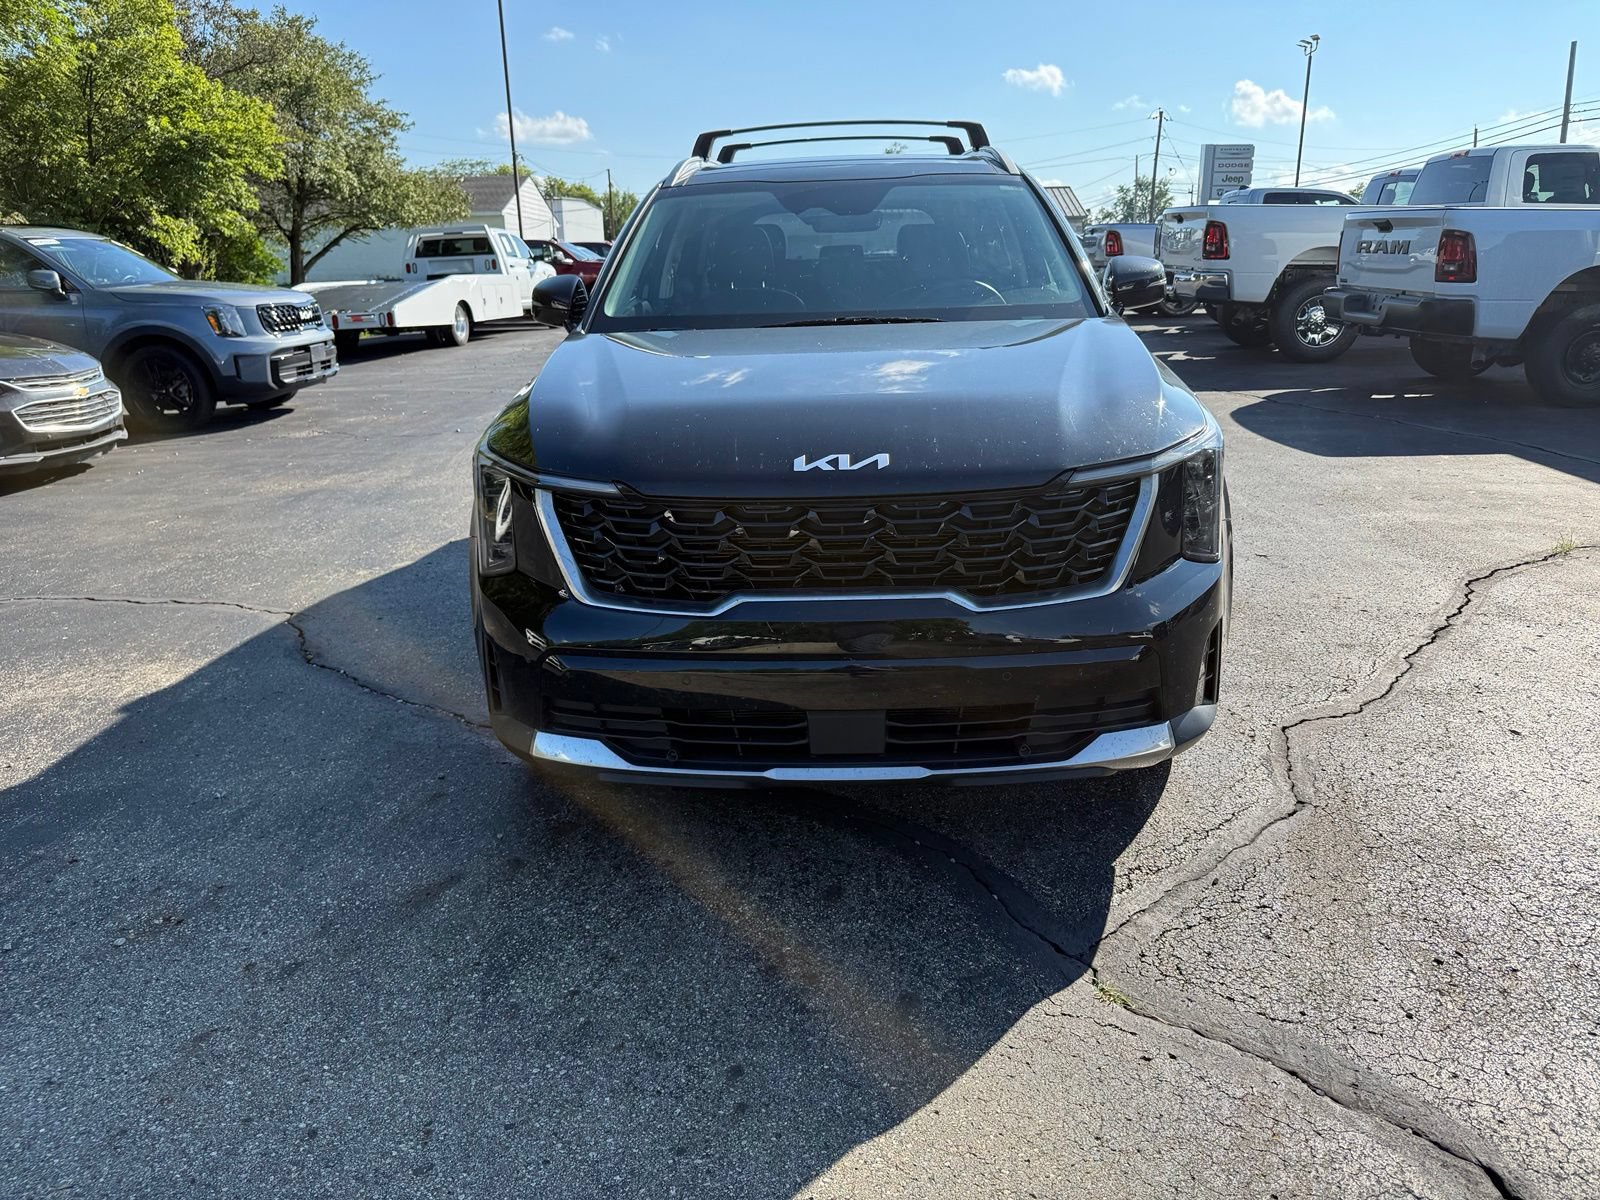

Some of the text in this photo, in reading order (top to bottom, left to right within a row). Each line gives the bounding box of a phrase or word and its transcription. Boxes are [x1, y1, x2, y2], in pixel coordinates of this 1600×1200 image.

[1221, 174, 1244, 183] Jeep
[1356, 239, 1411, 255] RAM
[793, 453, 890, 471] KIA
